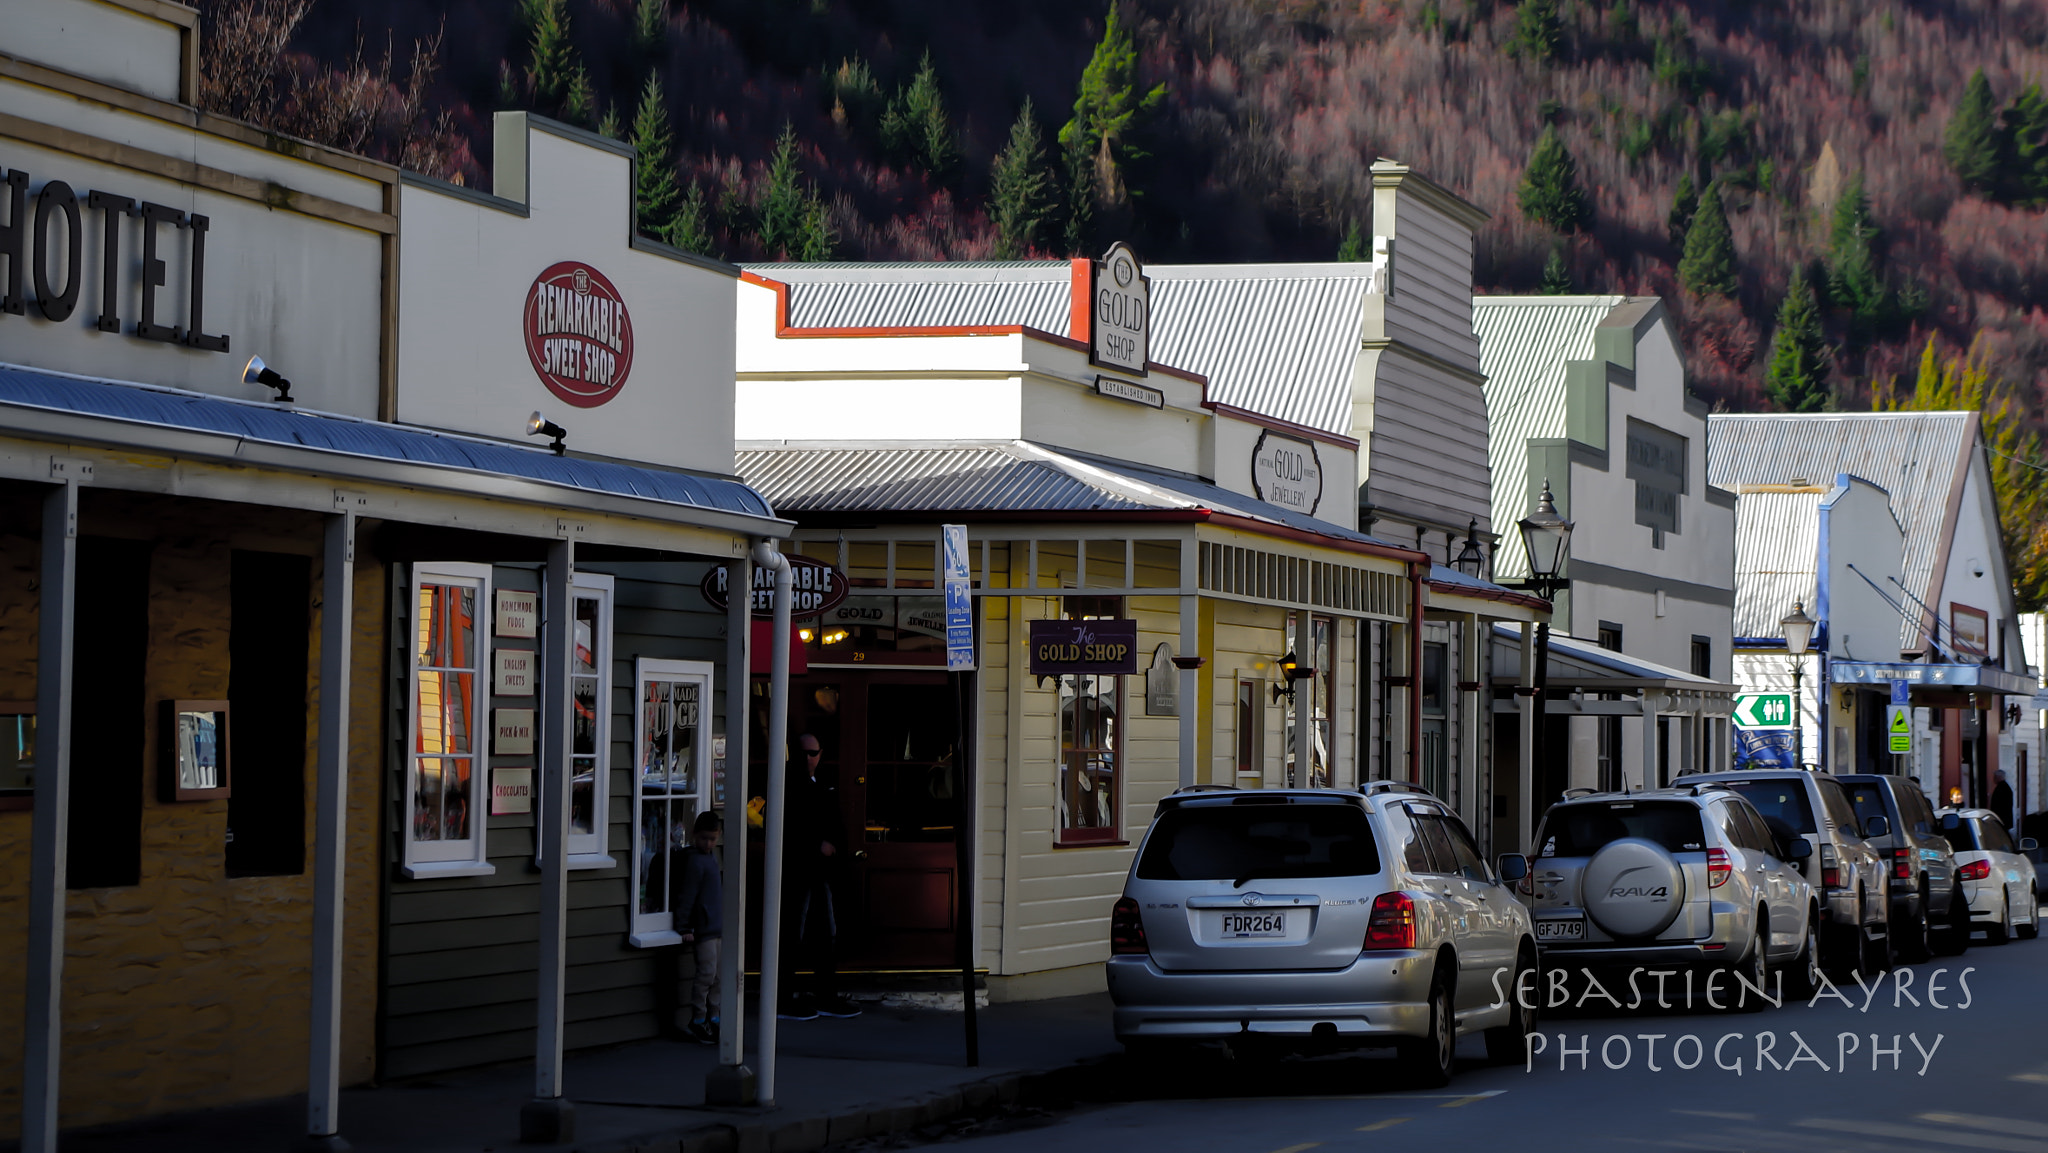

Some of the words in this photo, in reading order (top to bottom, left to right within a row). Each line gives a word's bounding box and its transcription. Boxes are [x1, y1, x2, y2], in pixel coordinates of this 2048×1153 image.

[0, 166, 229, 353] HOTEL
[1117, 263, 1129, 280] THE
[575, 275, 587, 289] THE
[537, 281, 624, 355] REMARKABLE
[1099, 288, 1143, 332] GOLD
[1106, 333, 1135, 362] SHOP
[543, 338, 582, 380] SWEET
[584, 343, 616, 387] SHOP
[1105, 382, 1144, 400] ESTABLISHED
[1274, 448, 1303, 482] GOLD
[1270, 482, 1307, 508] JEWELLERY
[952, 528, 960, 550] P
[717, 566, 833, 593] RARABLE
[787, 591, 823, 610] HOP
[955, 584, 963, 604] P
[501, 600, 532, 613] HOMEMADE
[837, 607, 883, 620] GOLD
[507, 616, 525, 628] FUDGE
[1071, 625, 1096, 645] The
[853, 652, 865, 661] 29
[1038, 643, 1081, 662] GOLD
[1084, 643, 1128, 662] SHOP
[504, 659, 527, 671] ENGLISH
[505, 675, 525, 686] SWEETS
[500, 726, 512, 738] PICK
[513, 725, 518, 738] &
[519, 727, 529, 738] MIX
[495, 784, 528, 797] CHOCOLATES
[1609, 886, 1668, 898] RAV4
[1224, 916, 1282, 932] FDR264
[1538, 923, 1582, 936] GFJ749
